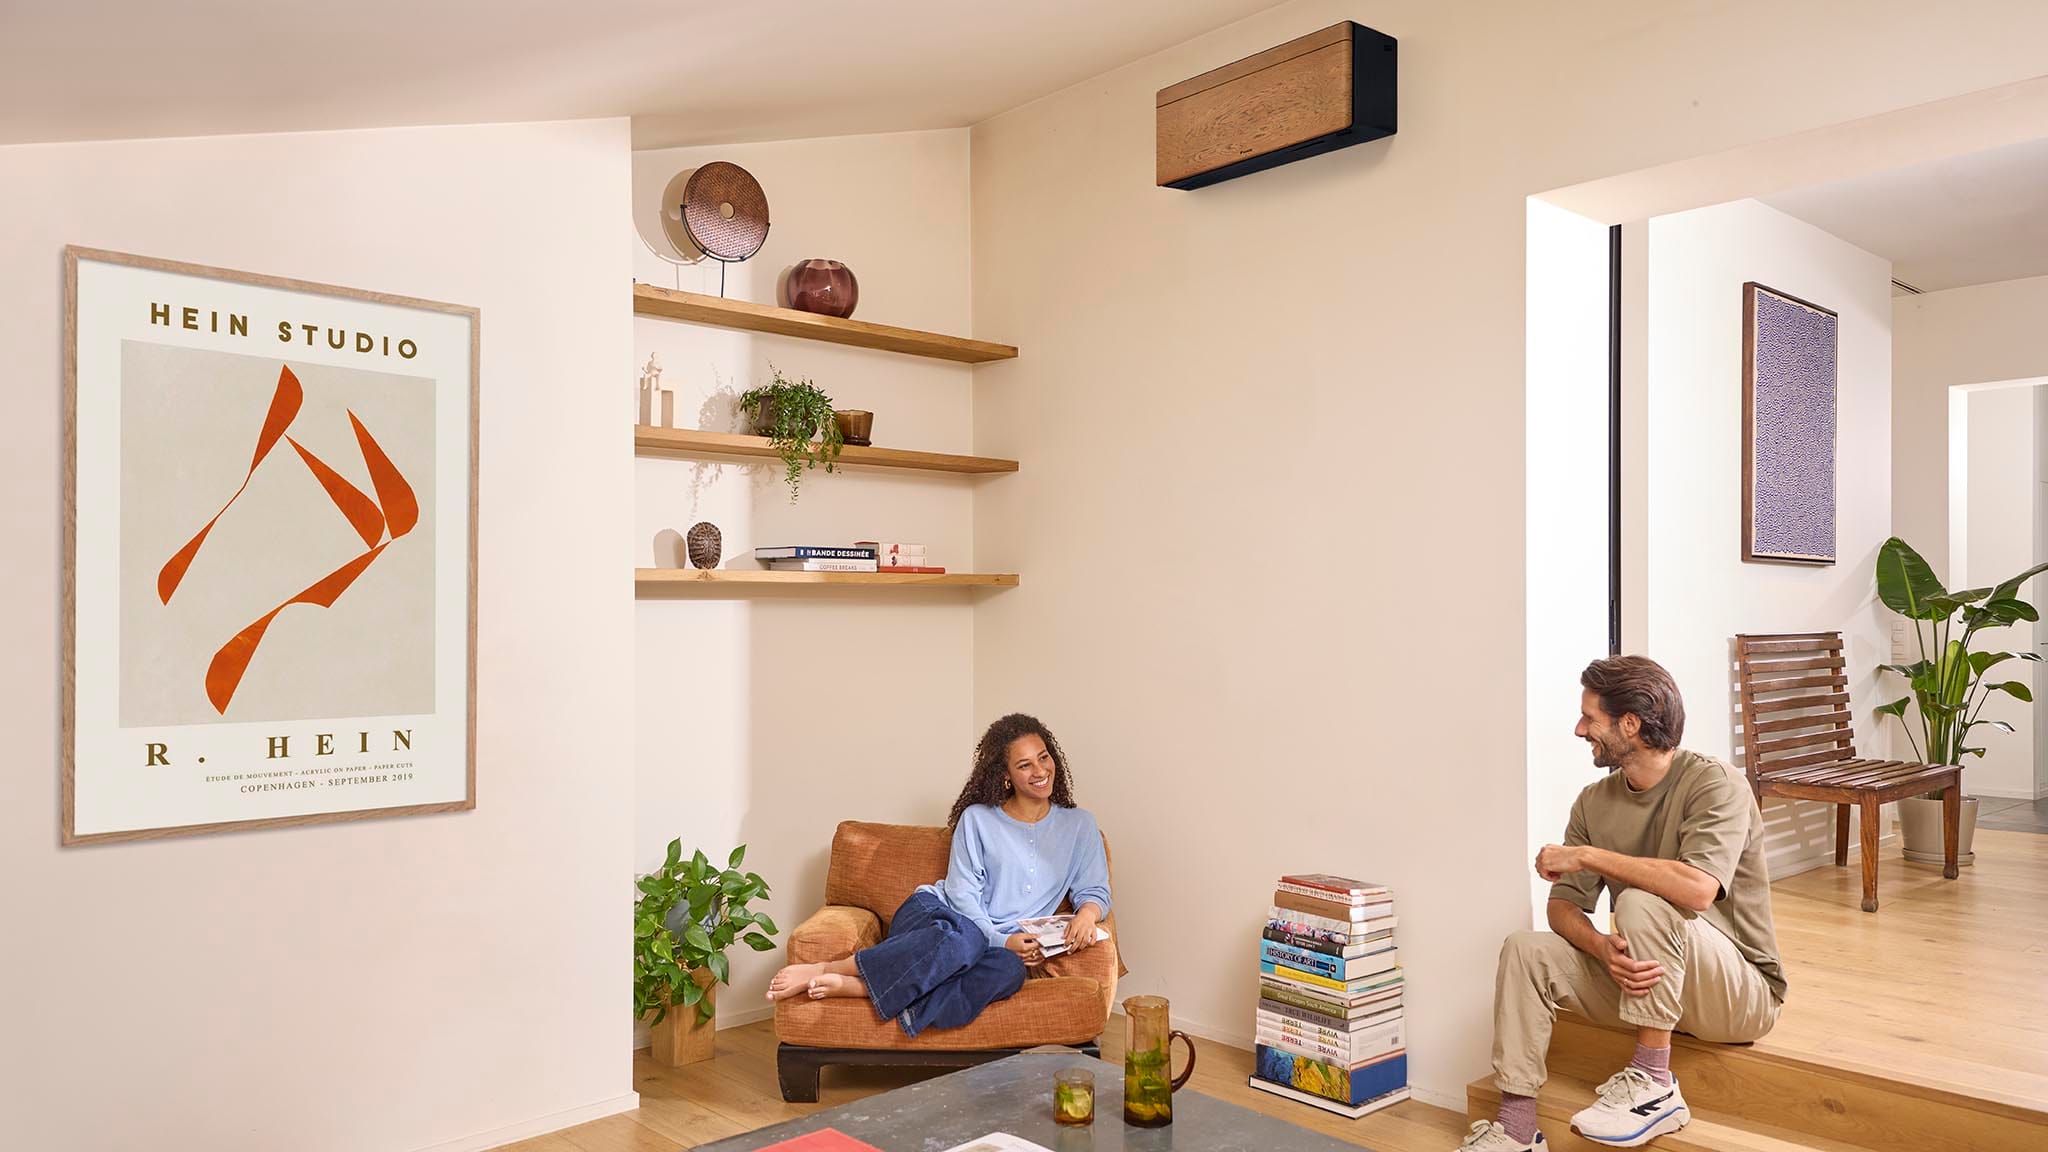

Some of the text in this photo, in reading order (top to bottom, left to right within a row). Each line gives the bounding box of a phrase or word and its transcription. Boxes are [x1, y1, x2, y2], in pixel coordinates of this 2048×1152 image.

[151, 302, 418, 360] HEIN STUDIO
[811, 549, 836, 557] BANDE
[837, 549, 870, 558] DESSINÉE
[266, 729, 413, 759] HEIN
[233, 773, 244, 781] DE
[246, 770, 294, 780] MOUVEMENT
[301, 767, 332, 776] ACRYLIC
[333, 766, 344, 774] ON
[346, 765, 367, 773] PAPER
[374, 763, 395, 771] PAPER
[240, 780, 316, 794] COPENHAGEN
[328, 774, 389, 787] SEPTEMBER
[392, 772, 414, 782] 2019
[1270, 948, 1294, 961] HISTORY
[1281, 1034, 1302, 1046] TERRE
[1317, 1044, 1338, 1057] VIVRE
